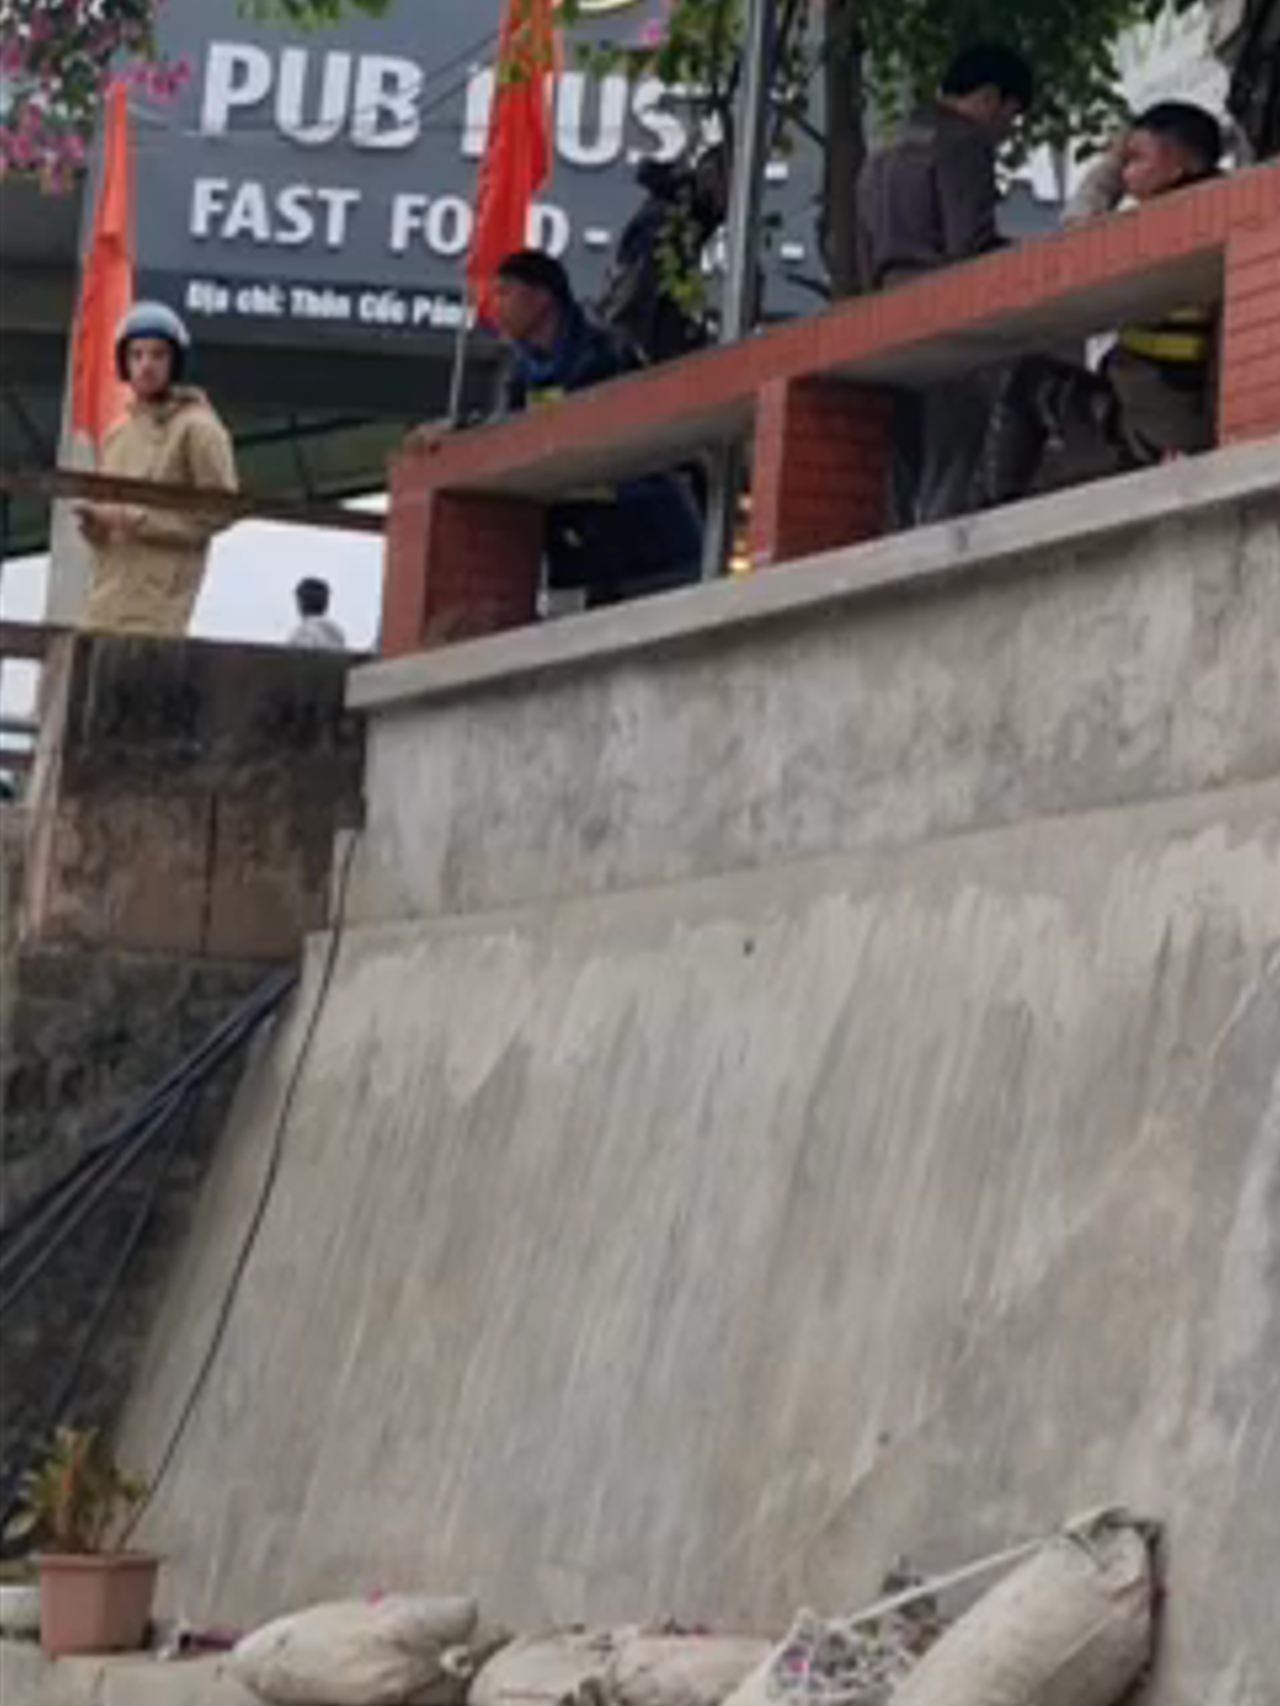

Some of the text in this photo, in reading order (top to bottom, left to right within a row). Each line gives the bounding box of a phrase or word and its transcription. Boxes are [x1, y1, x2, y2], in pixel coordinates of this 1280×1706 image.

[202, 40, 425, 149] PUB
[190, 178, 362, 247] FAST
[390, 193, 571, 259] FOD
